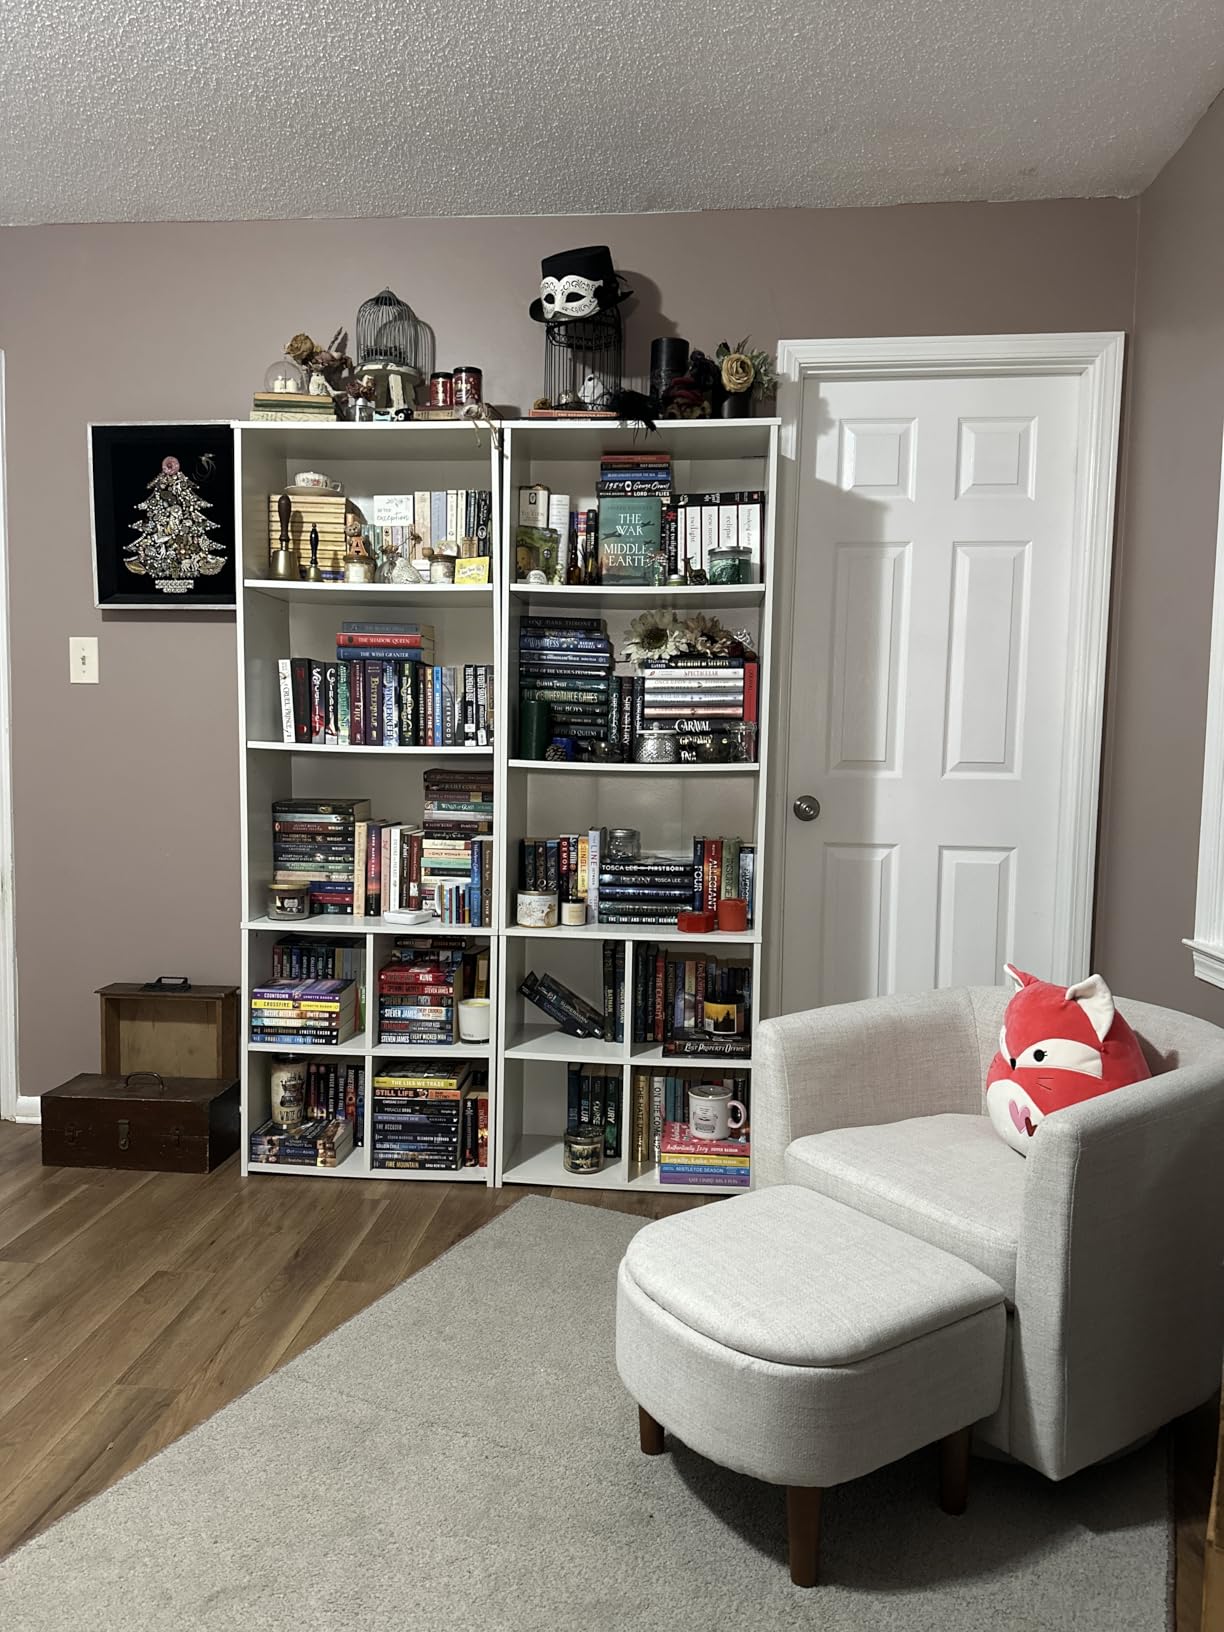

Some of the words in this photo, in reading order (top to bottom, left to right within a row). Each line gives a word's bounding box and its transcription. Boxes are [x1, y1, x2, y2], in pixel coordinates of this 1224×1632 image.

[605, 482, 624, 490] 1984
[633, 481, 651, 491] George
[652, 481, 670, 490] Orwell
[618, 513, 642, 524] THE
[722, 516, 733, 540] eclipse
[616, 525, 644, 536] WAR
[690, 516, 698, 543] twilight
[312, 668, 322, 732] Scarlet
[676, 719, 712, 733] CARAVAL
[694, 865, 703, 892] FOUR
[708, 858, 718, 912] ALLEGIANT
[724, 858, 735, 899] INSURGE
[384, 1008, 401, 1018] STEVEN
[402, 1009, 417, 1018] JAMES
[655, 988, 663, 1021] CLACKITY
[698, 1043, 725, 1052] PROPERTY
[654, 1087, 662, 1098] ON
[580, 1100, 589, 1122] BLUR
[592, 1100, 601, 1126] CURSE
[607, 1101, 616, 1124] FURY
[654, 1100, 662, 1114] THE
[654, 1115, 662, 1136] COME
